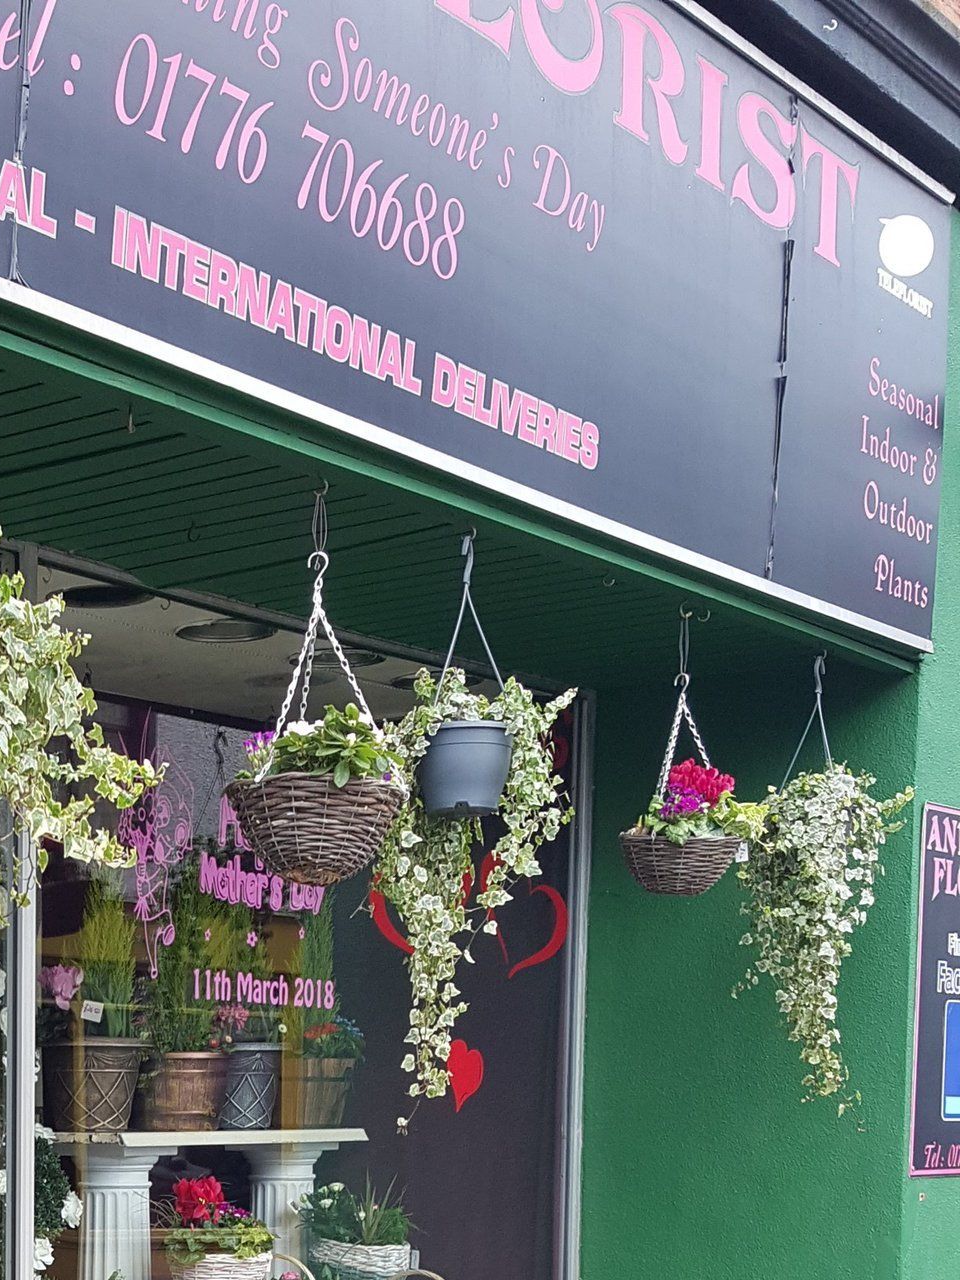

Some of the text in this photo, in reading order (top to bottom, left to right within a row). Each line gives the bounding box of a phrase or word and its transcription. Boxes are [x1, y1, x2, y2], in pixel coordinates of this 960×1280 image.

[114, 33, 275, 184] 01776
[296, 119, 466, 280] 706688
[308, 17, 515, 188] Someone's
[531, 144, 606, 252] Day
[110, 204, 423, 396] INTERNATIONAL
[430, 351, 601, 470] DELIVERIES
[868, 356, 939, 430] Seasonal
[860, 414, 938, 486] Indoor &
[863, 480, 934, 545] Outdoor
[874, 553, 929, 609] Plants
[927, 814, 960, 859] AN
[931, 857, 960, 902] FL
[192, 968, 336, 1010] 11th March 2018
